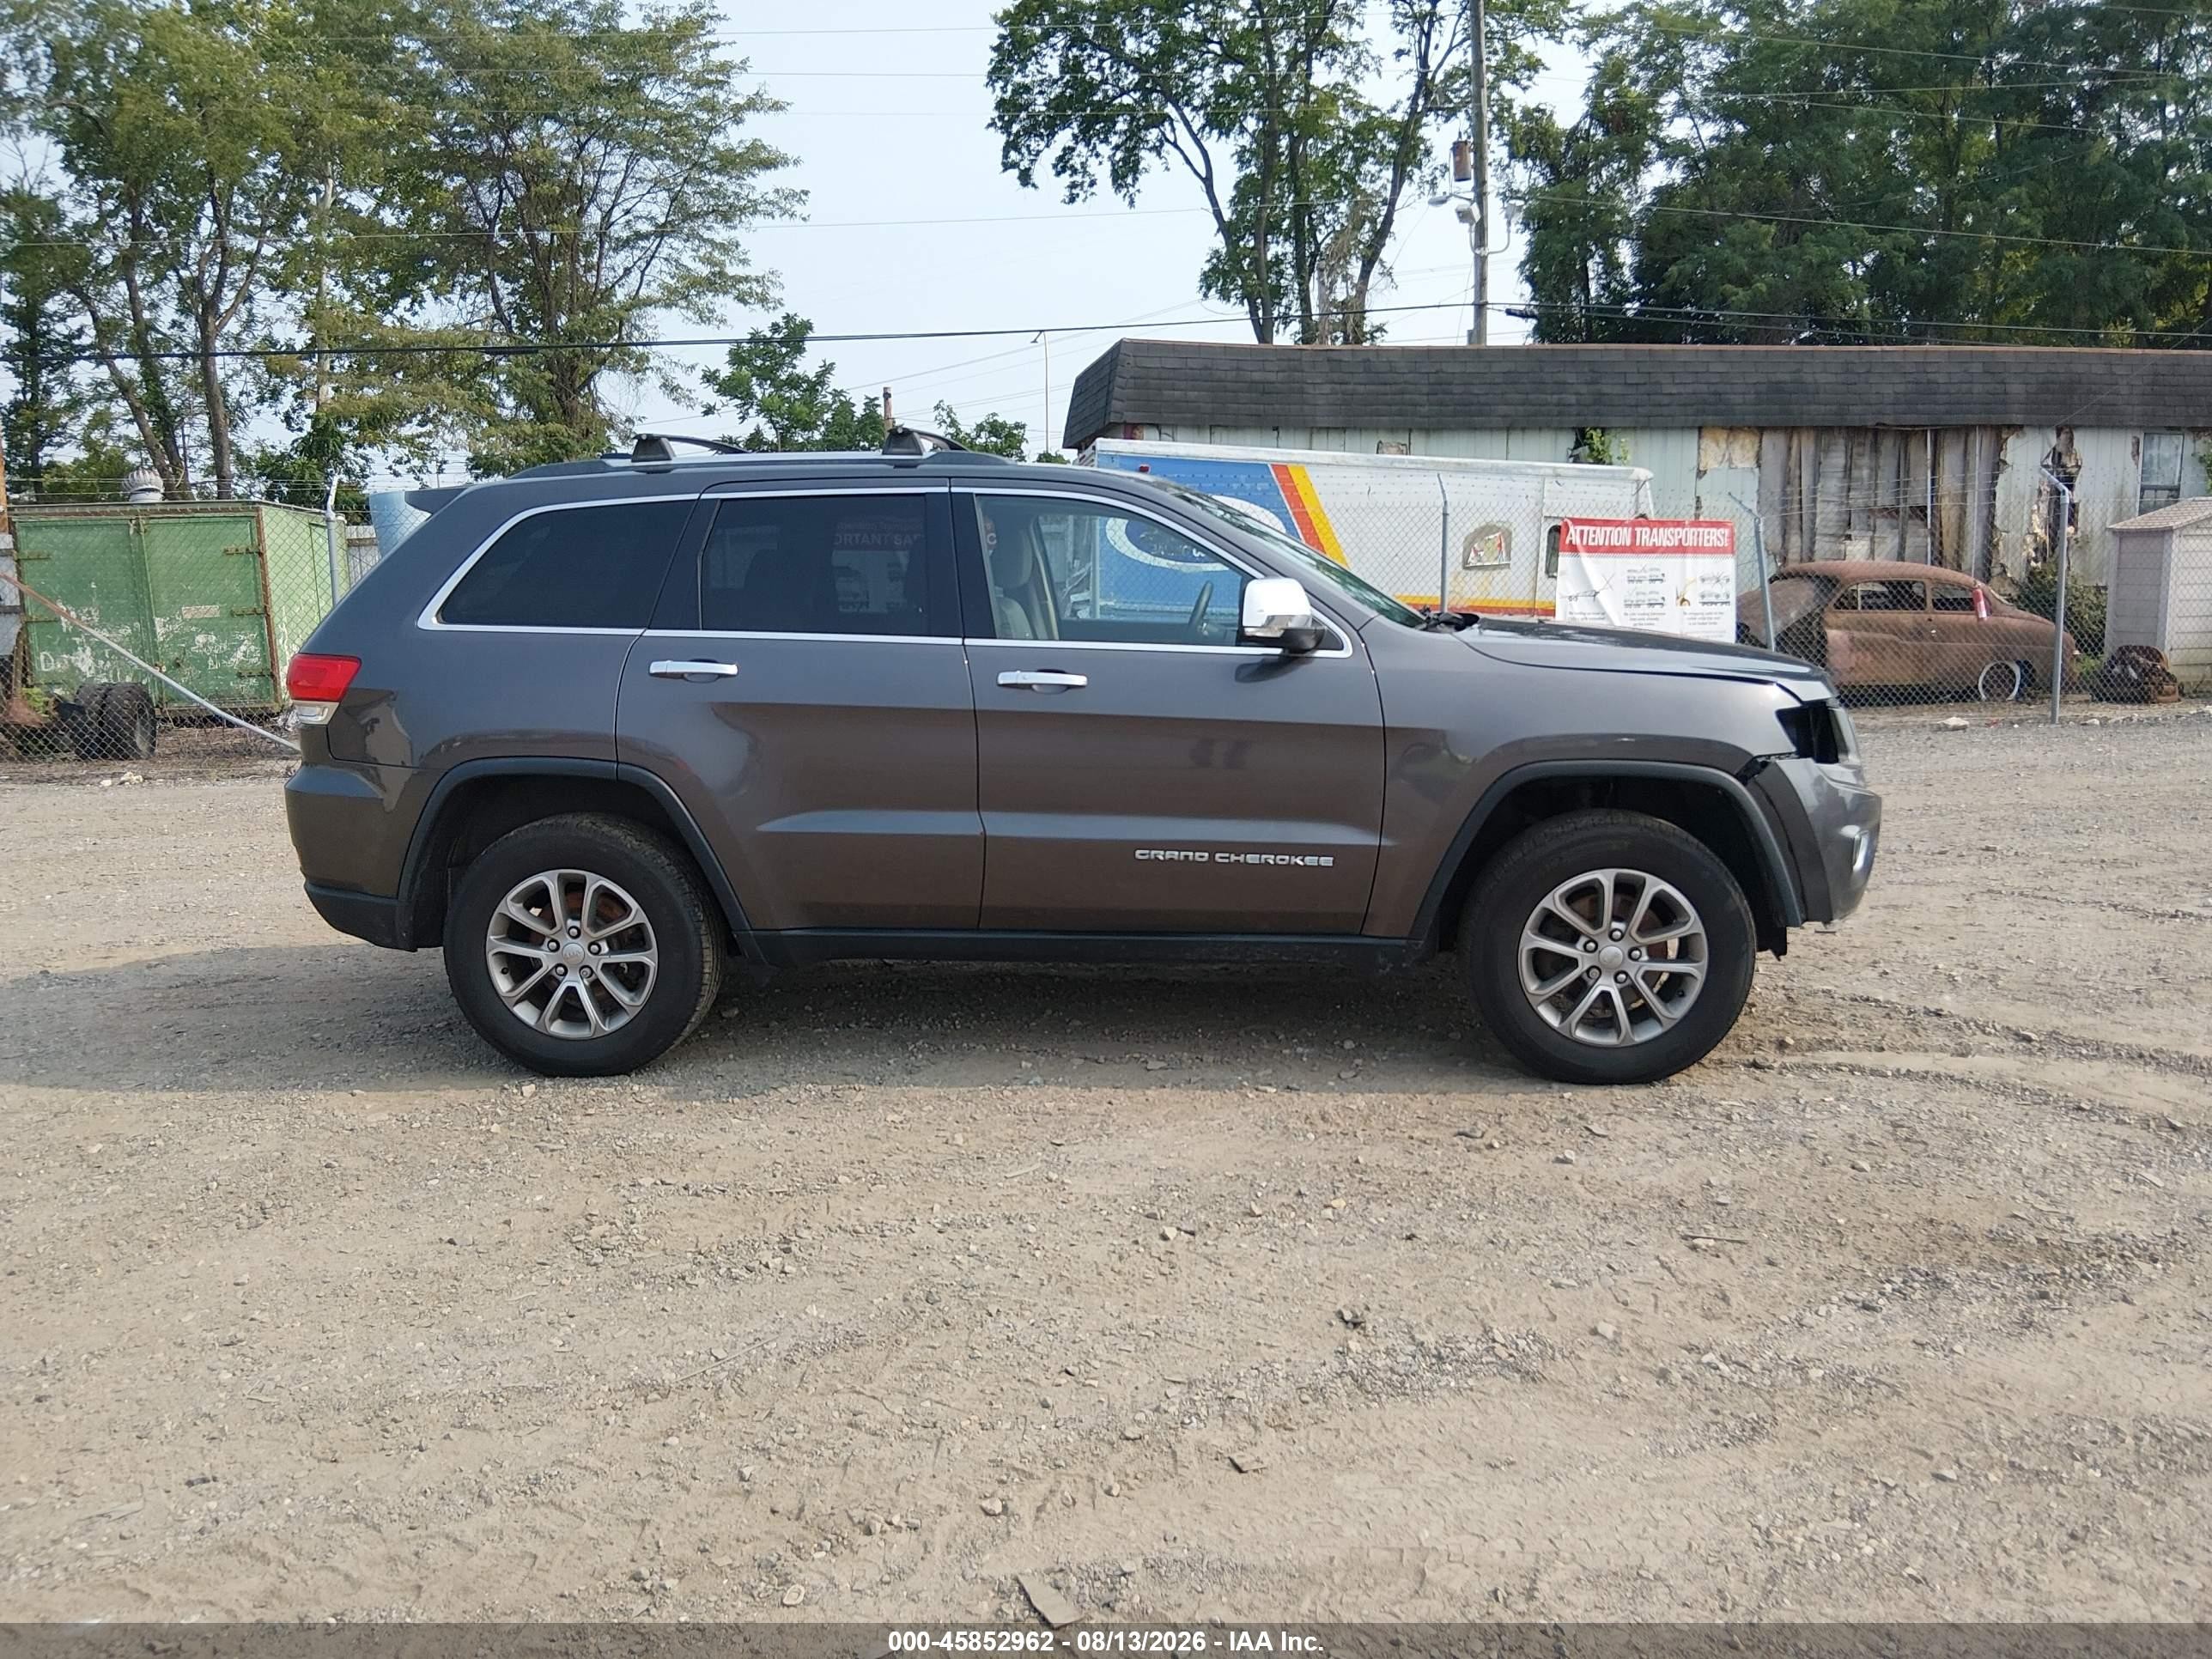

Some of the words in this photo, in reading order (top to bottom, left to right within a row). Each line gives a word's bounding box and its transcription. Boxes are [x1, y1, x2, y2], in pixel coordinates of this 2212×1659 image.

[1565, 526, 1632, 547] ATTENTION
[1634, 526, 1729, 548] TRANSPORTERS!
[1134, 849, 1209, 862] GRAND
[1214, 852, 1334, 866] CHEROKEE
